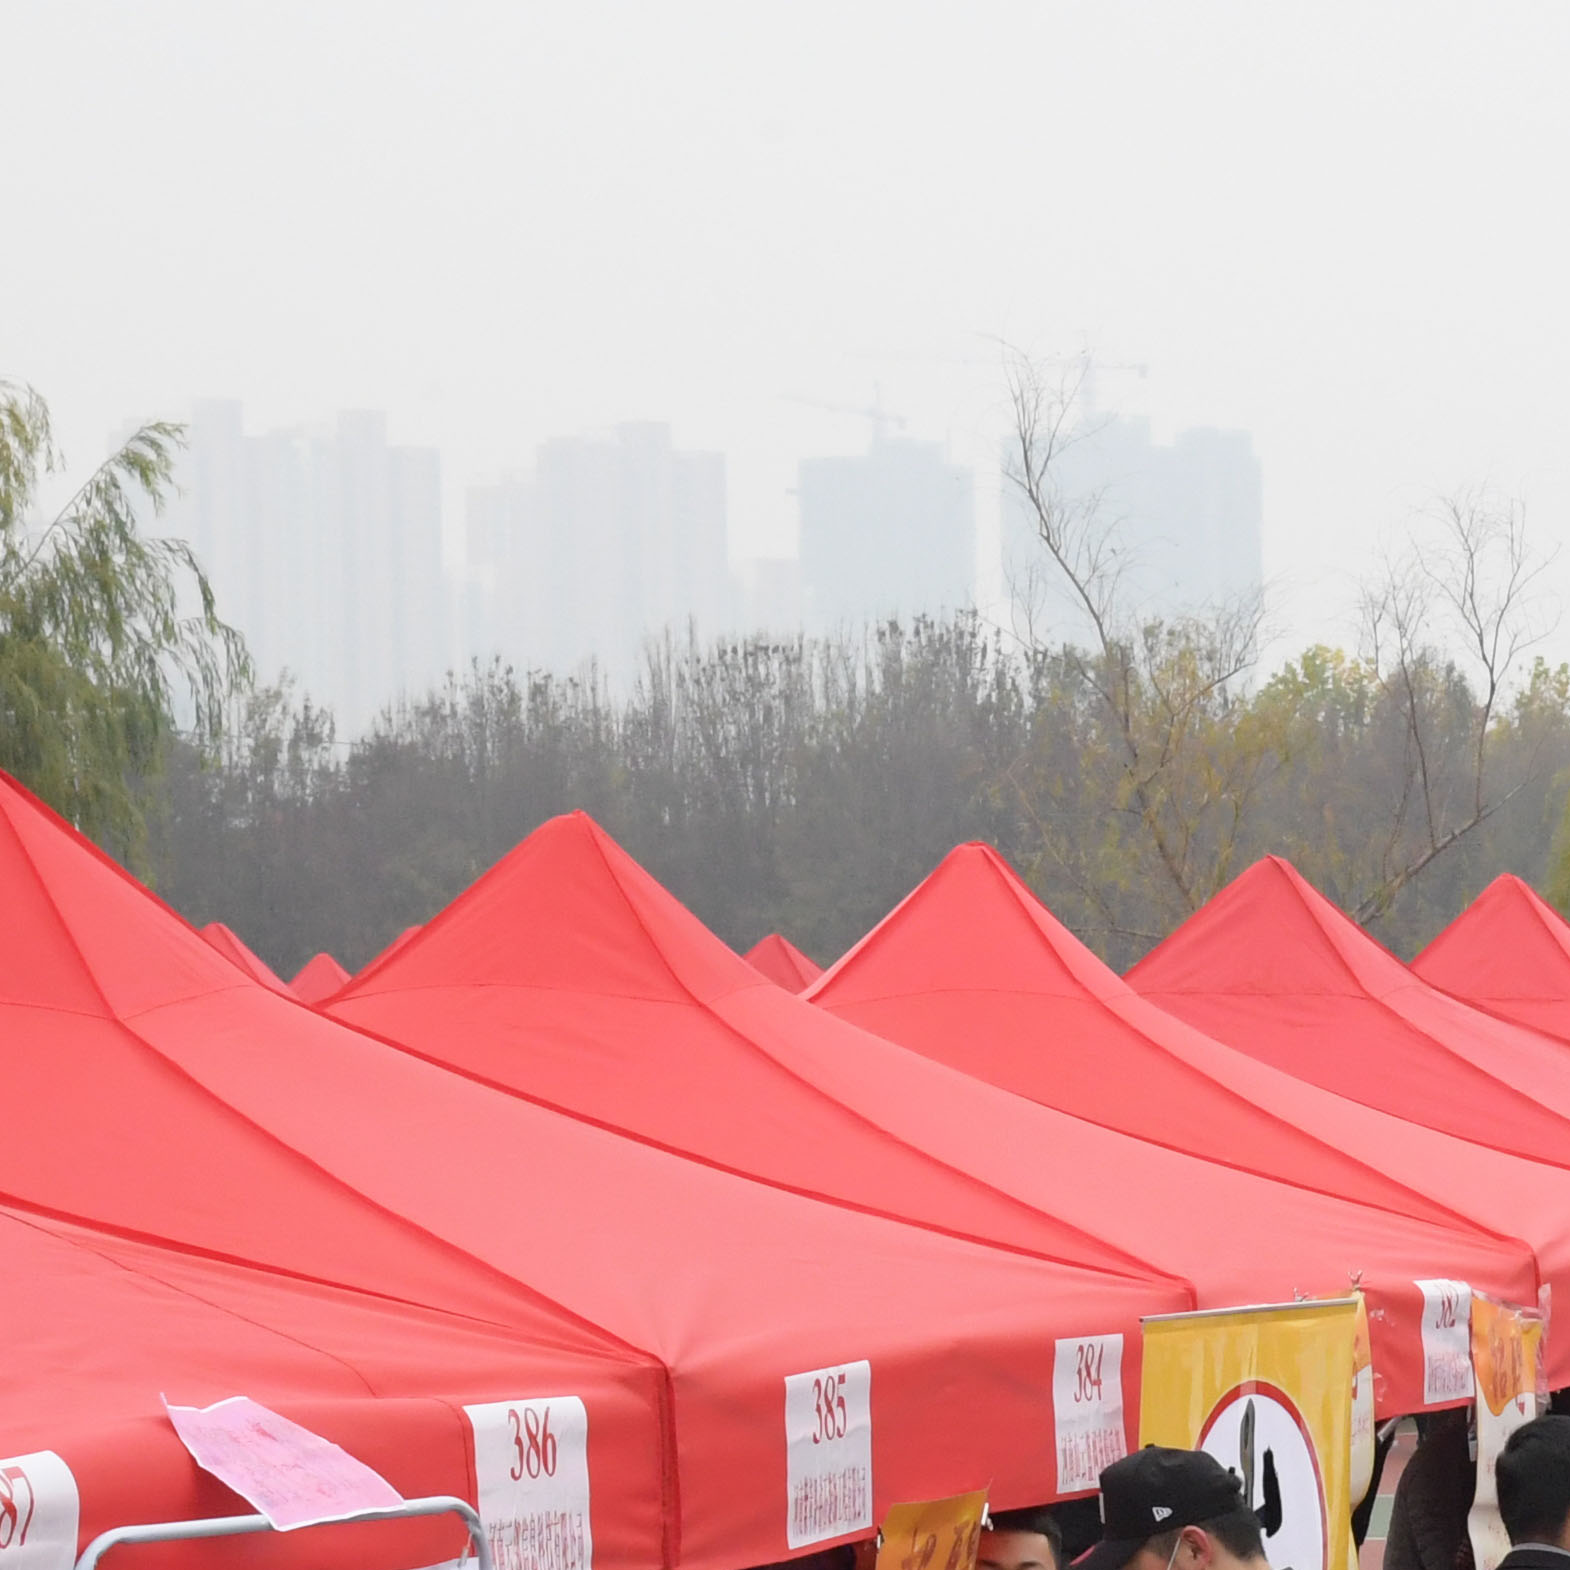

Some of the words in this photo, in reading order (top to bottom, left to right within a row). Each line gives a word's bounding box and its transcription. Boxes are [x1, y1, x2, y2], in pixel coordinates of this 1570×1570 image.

[812, 1373, 847, 1445] 385
[1074, 1343, 1103, 1403] 384
[508, 1406, 557, 1481] 386
